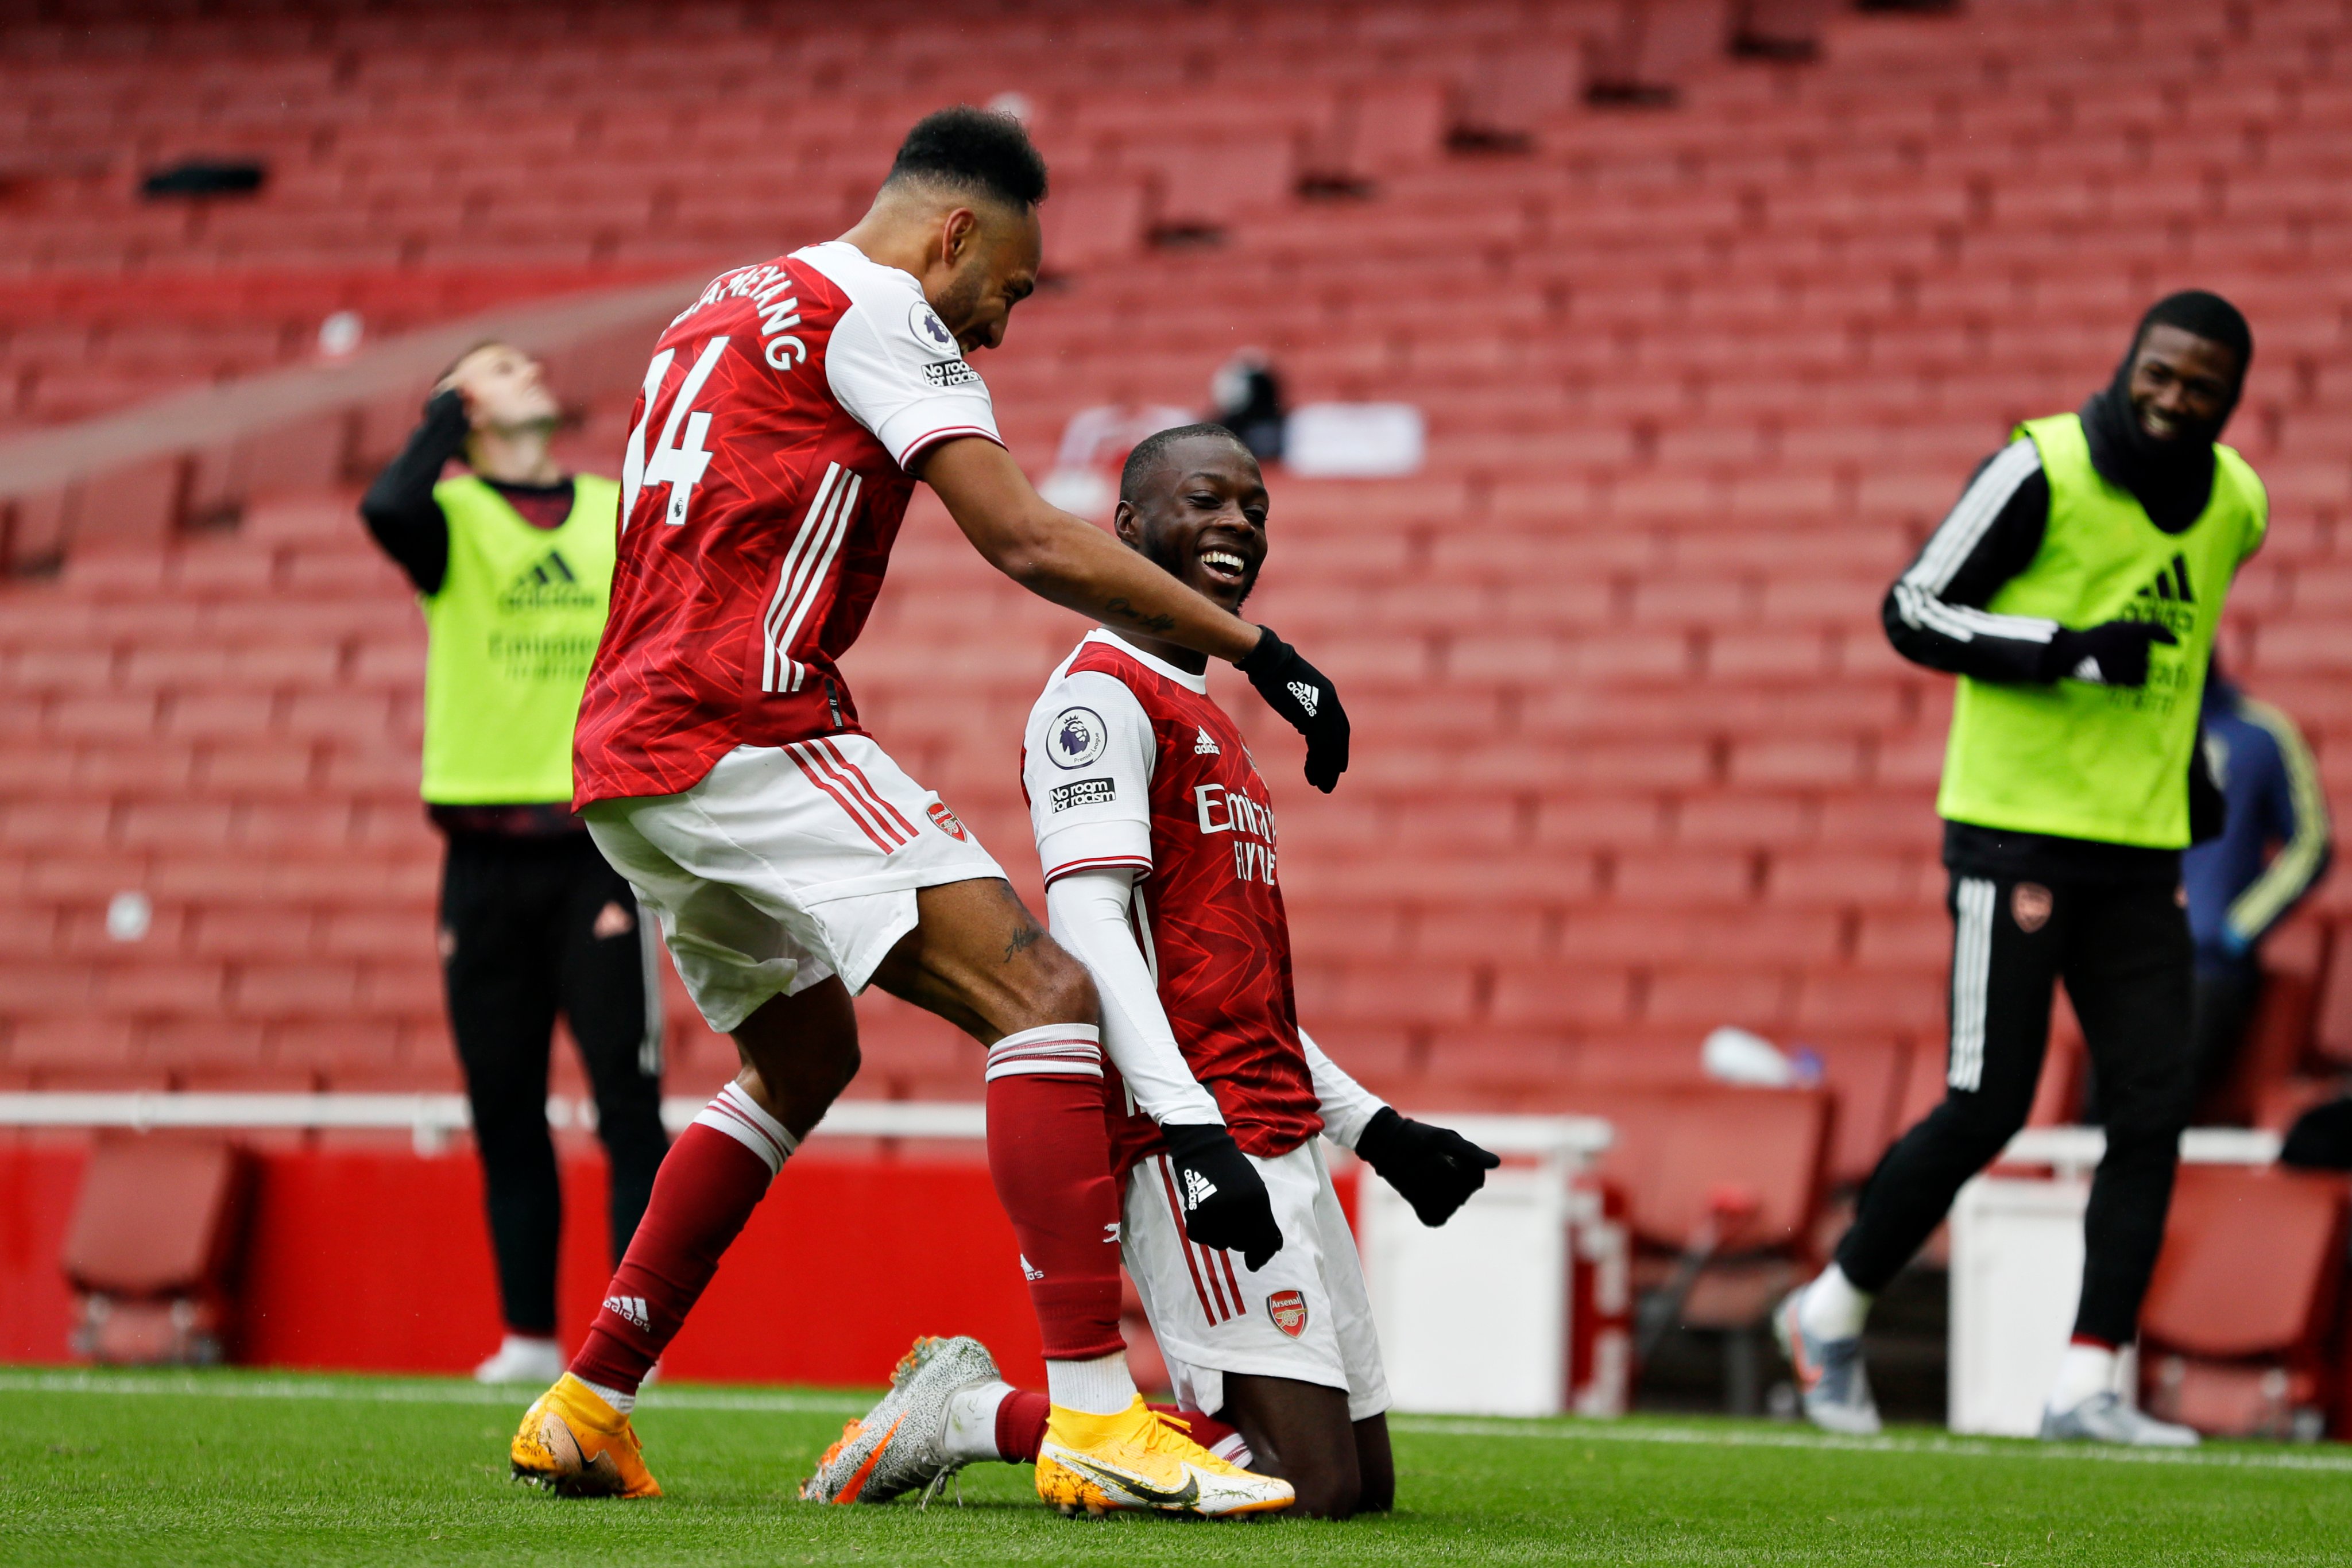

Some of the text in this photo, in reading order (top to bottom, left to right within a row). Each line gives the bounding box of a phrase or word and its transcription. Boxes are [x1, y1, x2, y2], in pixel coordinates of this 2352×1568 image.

[922, 361, 973, 377] No roo
[925, 375, 945, 386] for
[622, 335, 730, 535] 14
[1287, 682, 1317, 717] adidas
[1074, 732, 1101, 764] Premier League
[1194, 743, 1221, 756] adidas
[1049, 781, 1108, 801] No room
[1052, 791, 1116, 814] for racism
[1233, 841, 1256, 881] FLY
[1184, 1169, 1198, 1210] adidas
[1272, 1296, 1301, 1309] Arsenal
[602, 1300, 651, 1333] adidas
